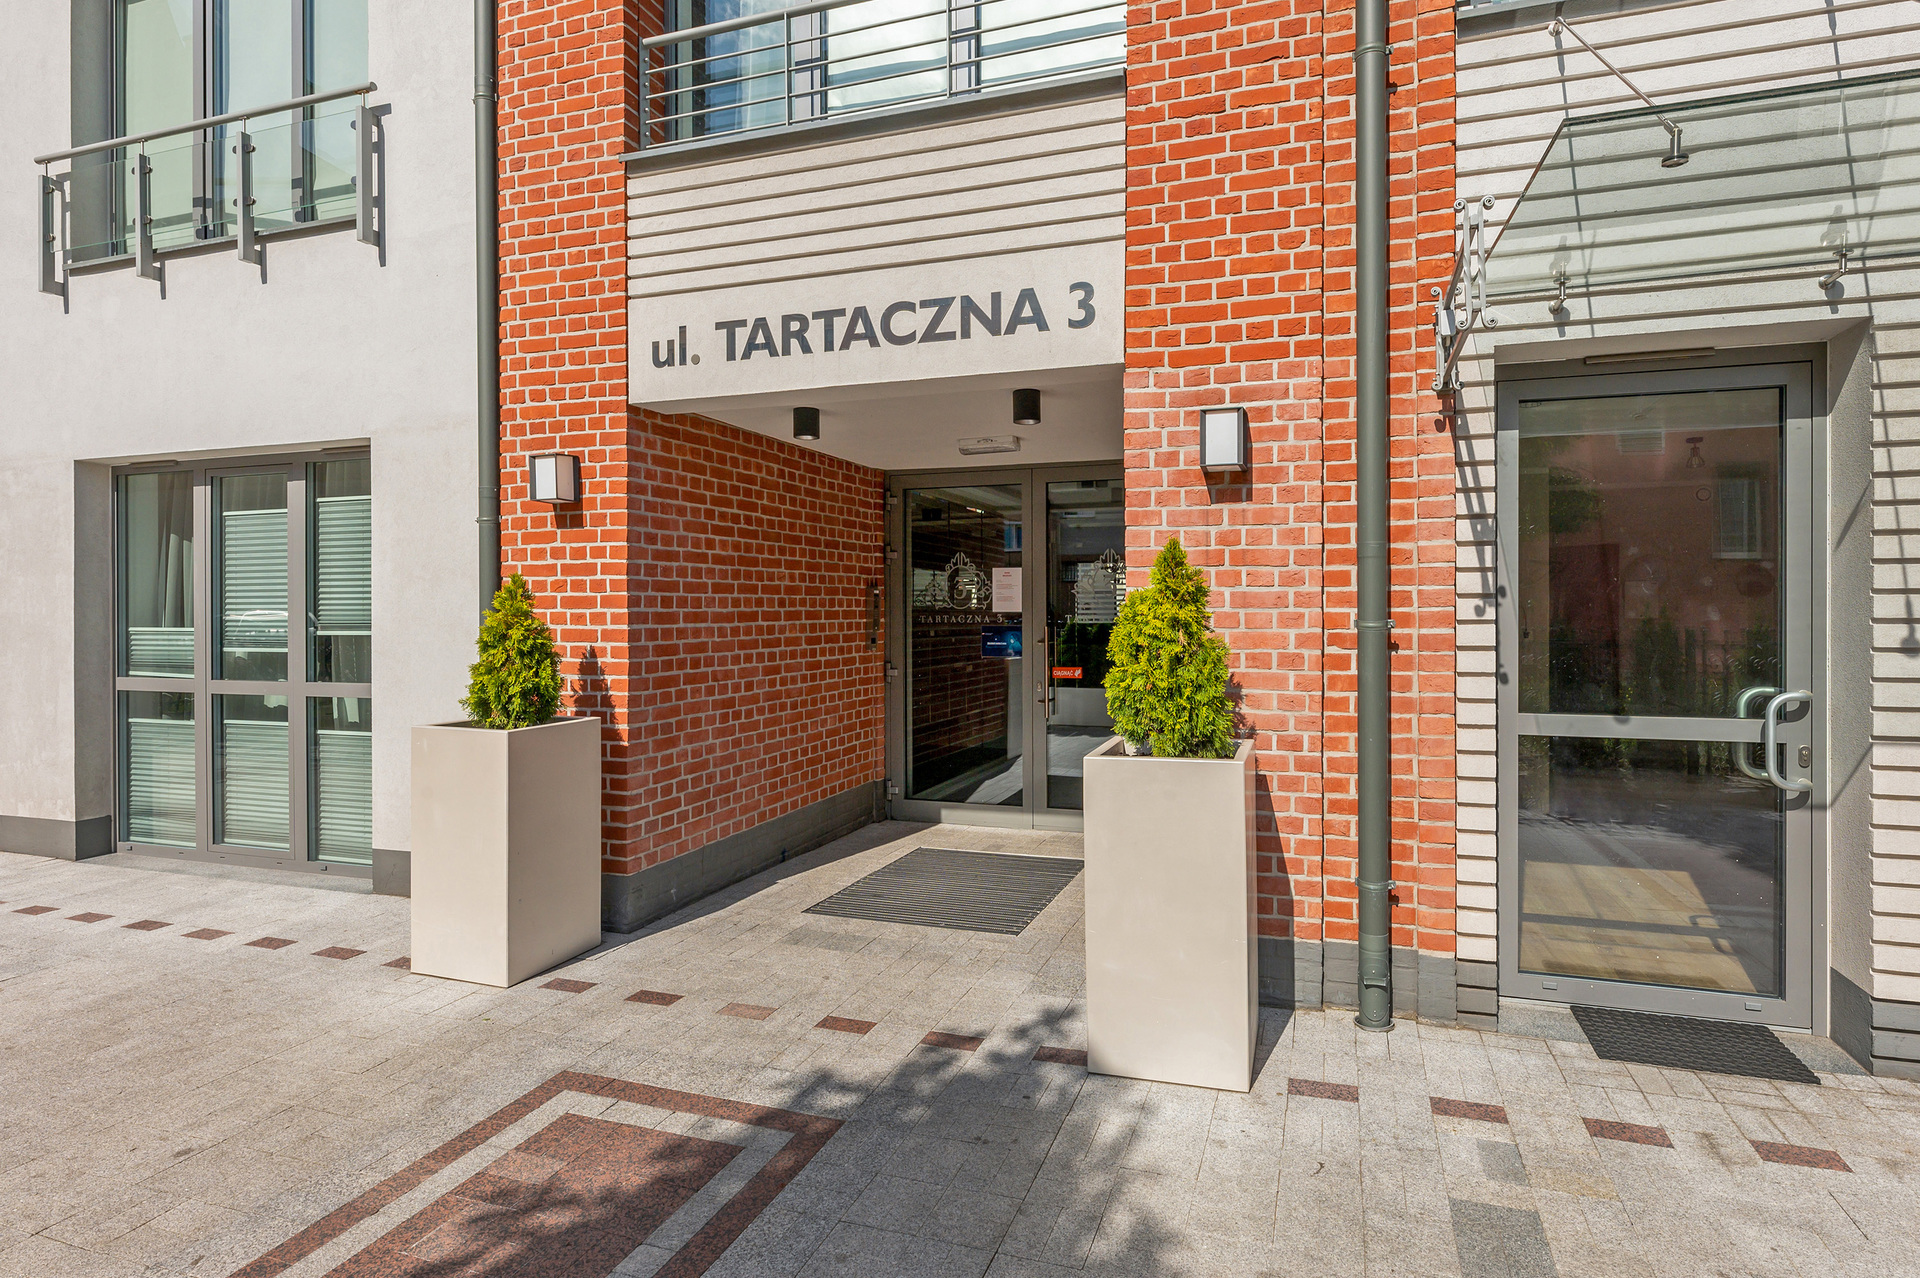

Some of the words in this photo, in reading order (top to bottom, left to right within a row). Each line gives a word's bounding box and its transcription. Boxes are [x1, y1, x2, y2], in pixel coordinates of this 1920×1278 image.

[651, 325, 701, 369] ul.
[715, 287, 1051, 362] TARTACZNA
[1067, 281, 1096, 330] 3
[919, 614, 991, 624] TARTACZNA
[996, 613, 1003, 624] 3
